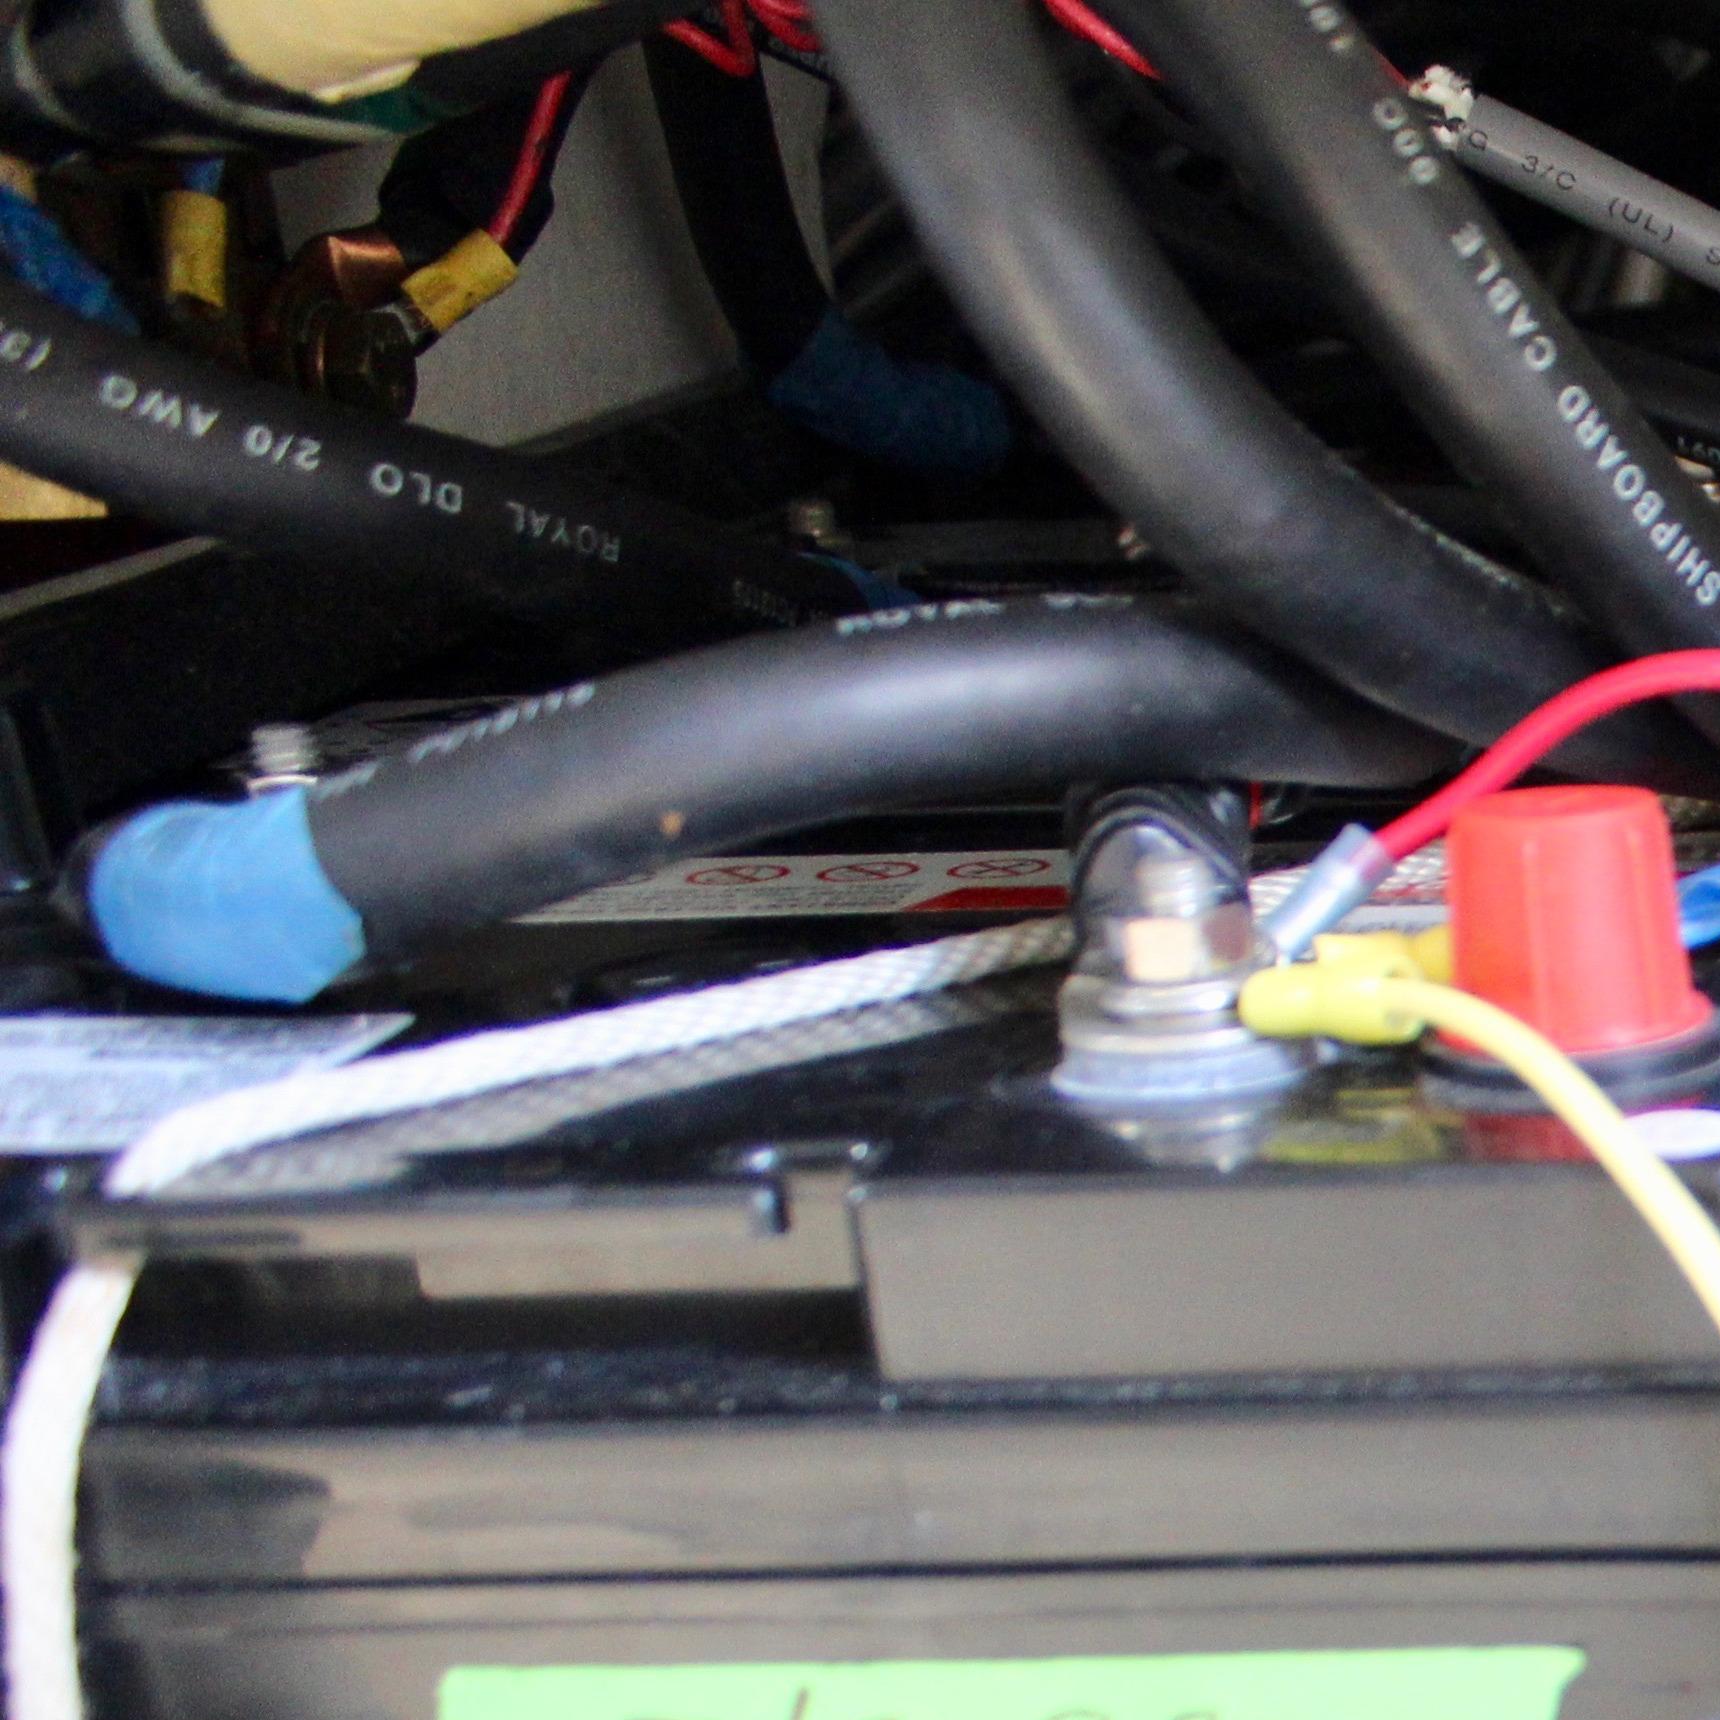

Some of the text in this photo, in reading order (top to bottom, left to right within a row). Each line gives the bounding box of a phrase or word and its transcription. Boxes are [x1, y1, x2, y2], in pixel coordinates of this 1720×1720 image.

[1520, 152, 1578, 192] 3/C
[1607, 195, 1675, 244] (UL)
[1449, 221, 1559, 372] CABLE
[101, 373, 622, 563] ROYAL DLO 2/0 AWG
